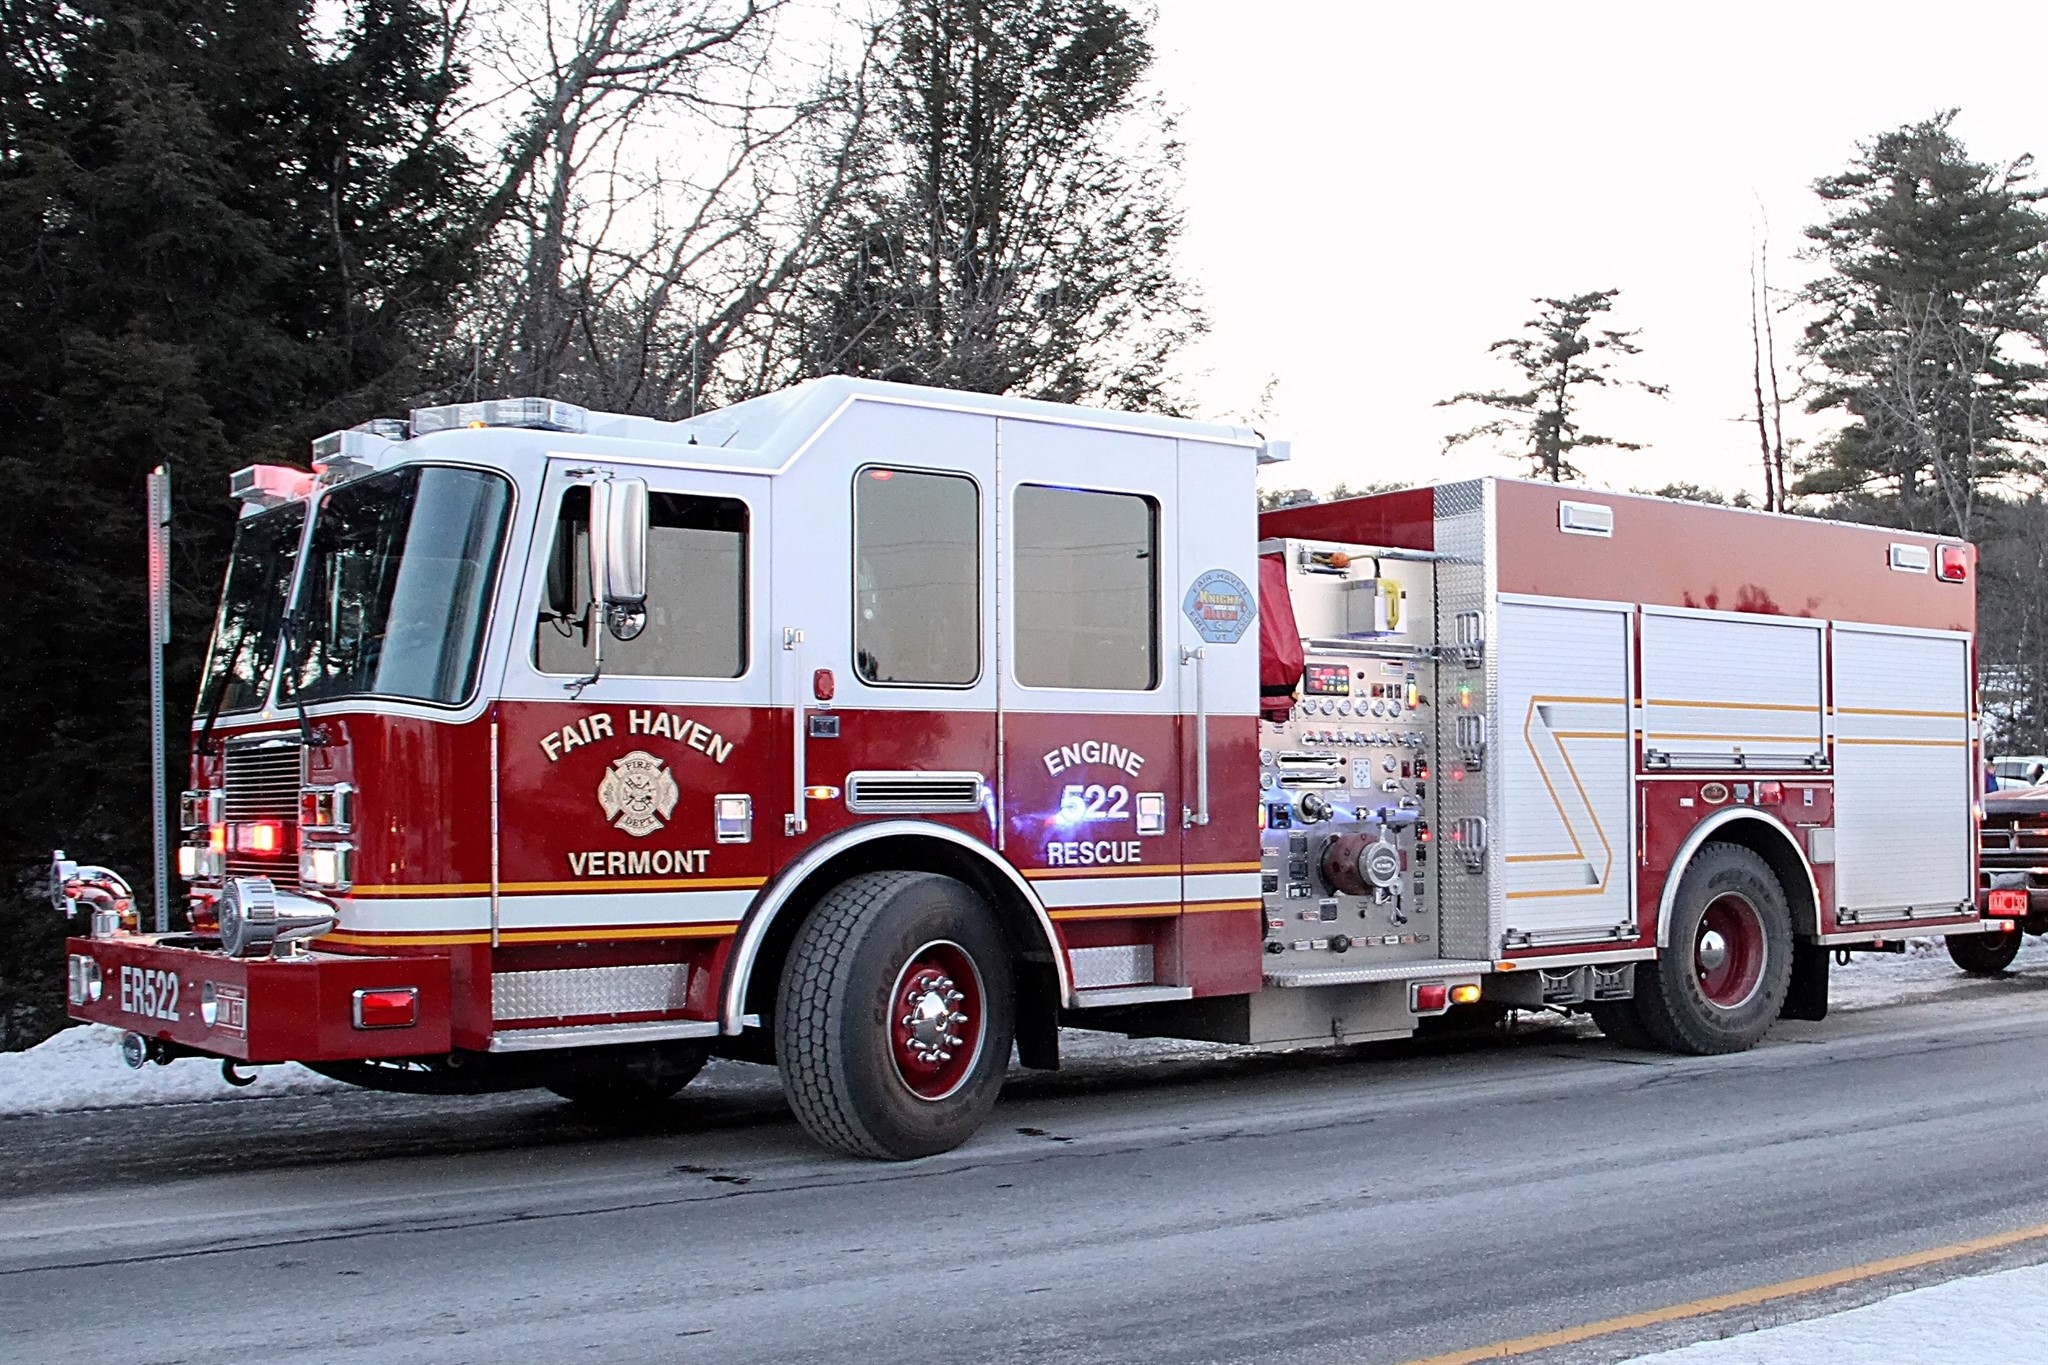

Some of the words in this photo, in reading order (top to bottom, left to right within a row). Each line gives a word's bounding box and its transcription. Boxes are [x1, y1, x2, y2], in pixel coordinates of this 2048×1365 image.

[1193, 574, 1212, 593] FAIR
[1217, 573, 1248, 595] HAVEN
[1189, 611, 1207, 634] FIRE
[1234, 611, 1254, 636] RESCUE
[540, 713, 614, 762] FAIR
[629, 709, 734, 764] HAVEN
[625, 761, 651, 771] FIRE
[1043, 740, 1145, 777] ENGINE
[1061, 784, 1129, 820] 522
[568, 850, 711, 876] VERMONT
[1047, 841, 1141, 865] RESCUE
[121, 965, 180, 1022] ER522
